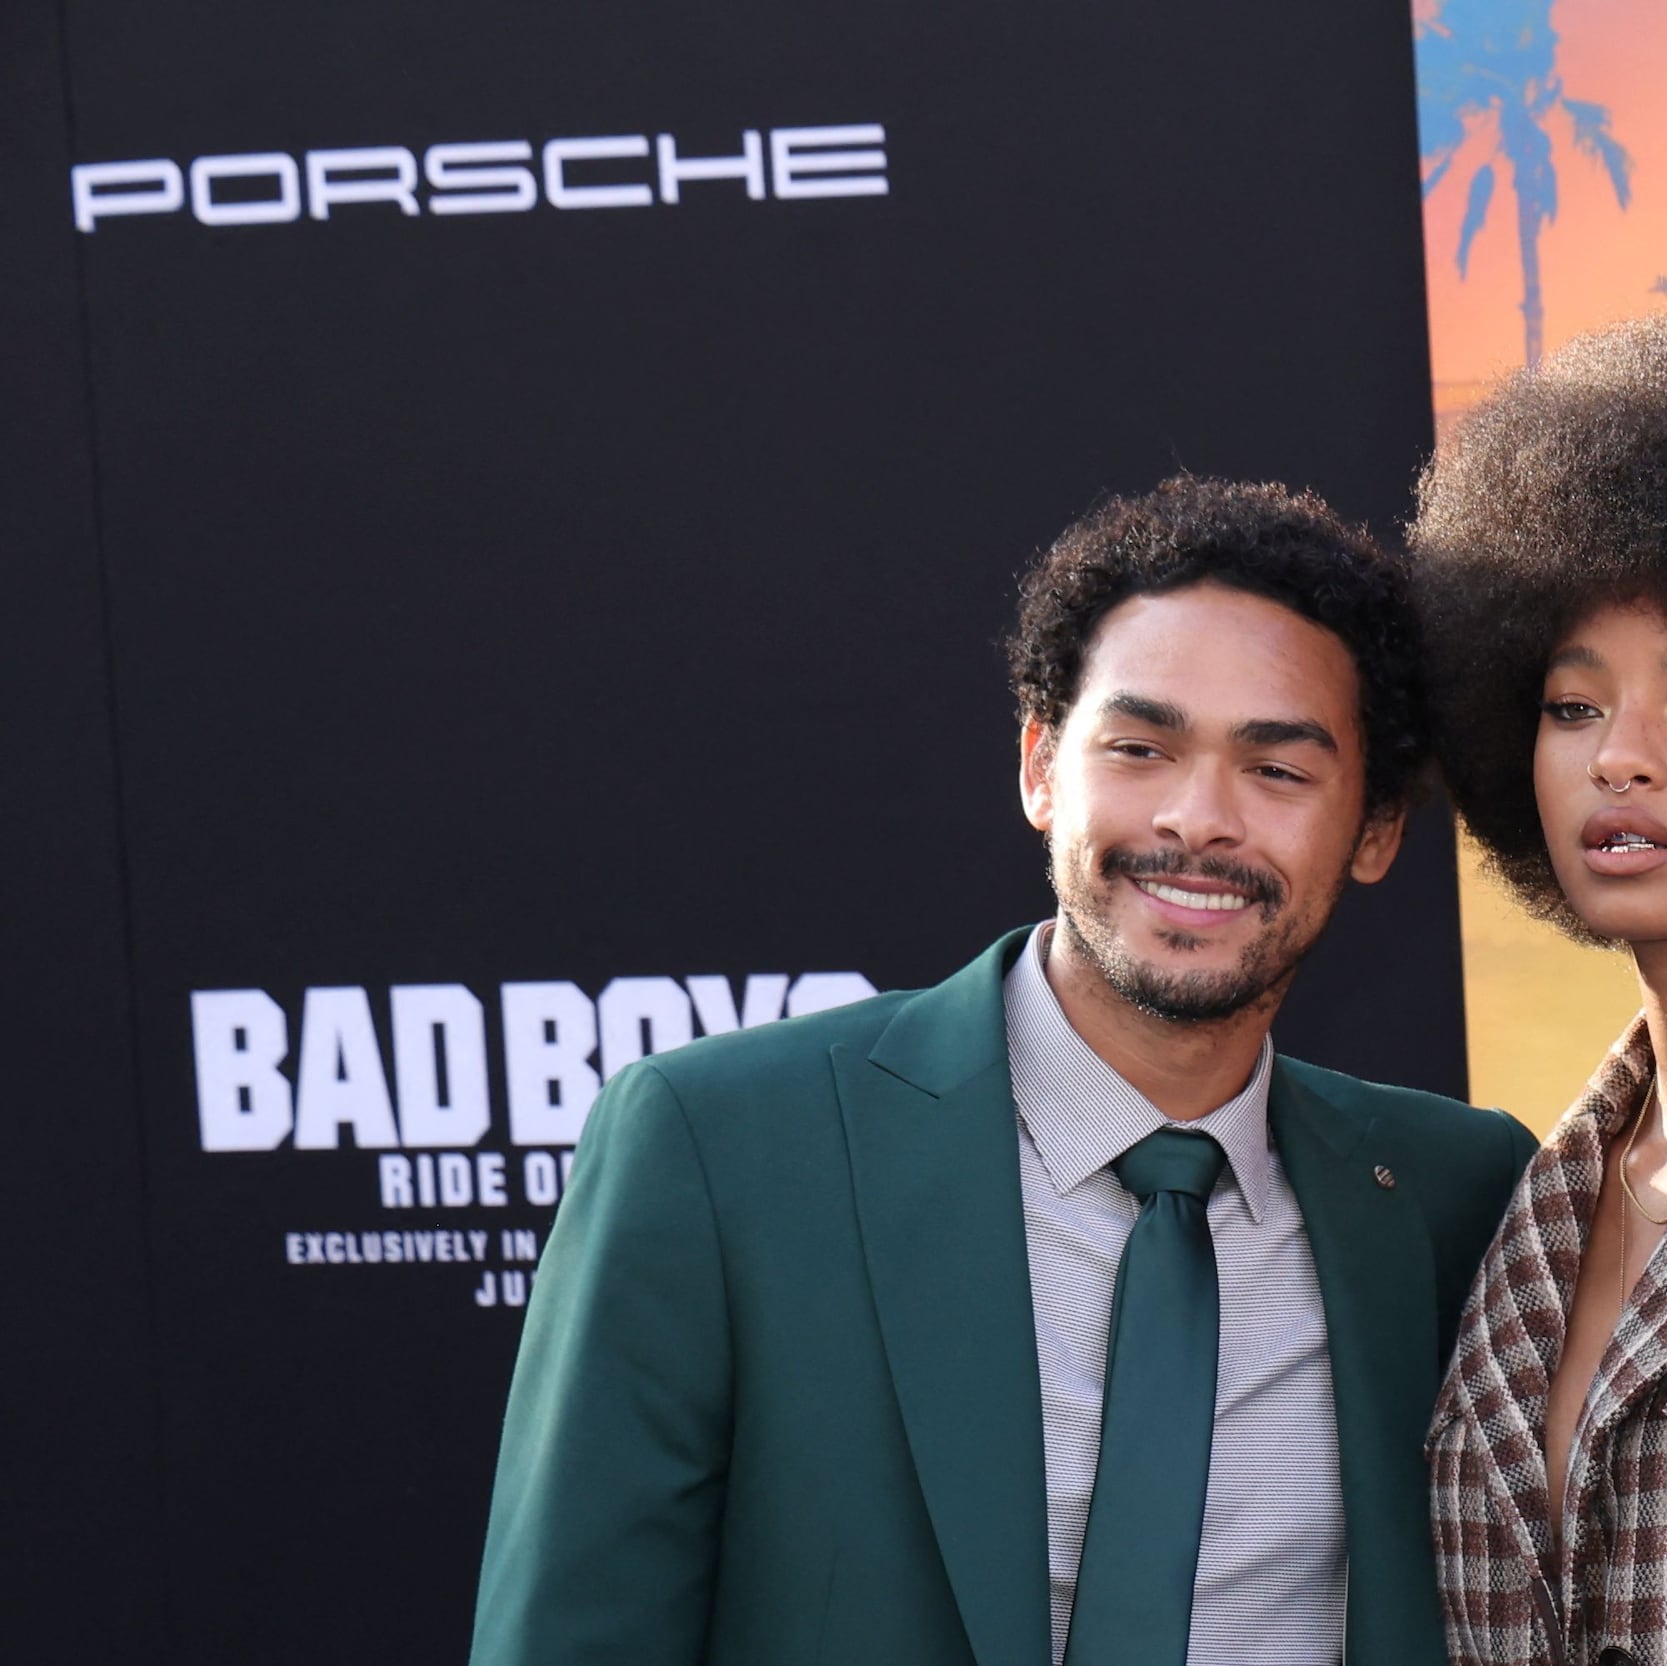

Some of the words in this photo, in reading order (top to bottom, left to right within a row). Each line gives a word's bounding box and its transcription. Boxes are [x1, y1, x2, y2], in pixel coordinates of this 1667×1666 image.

[70, 123, 889, 233] PORSCHE
[191, 985, 491, 1151] BAD
[379, 1154, 508, 1208] RIDE
[286, 1231, 488, 1264] EXCLUSIVELY
[502, 1230, 537, 1261] IN
